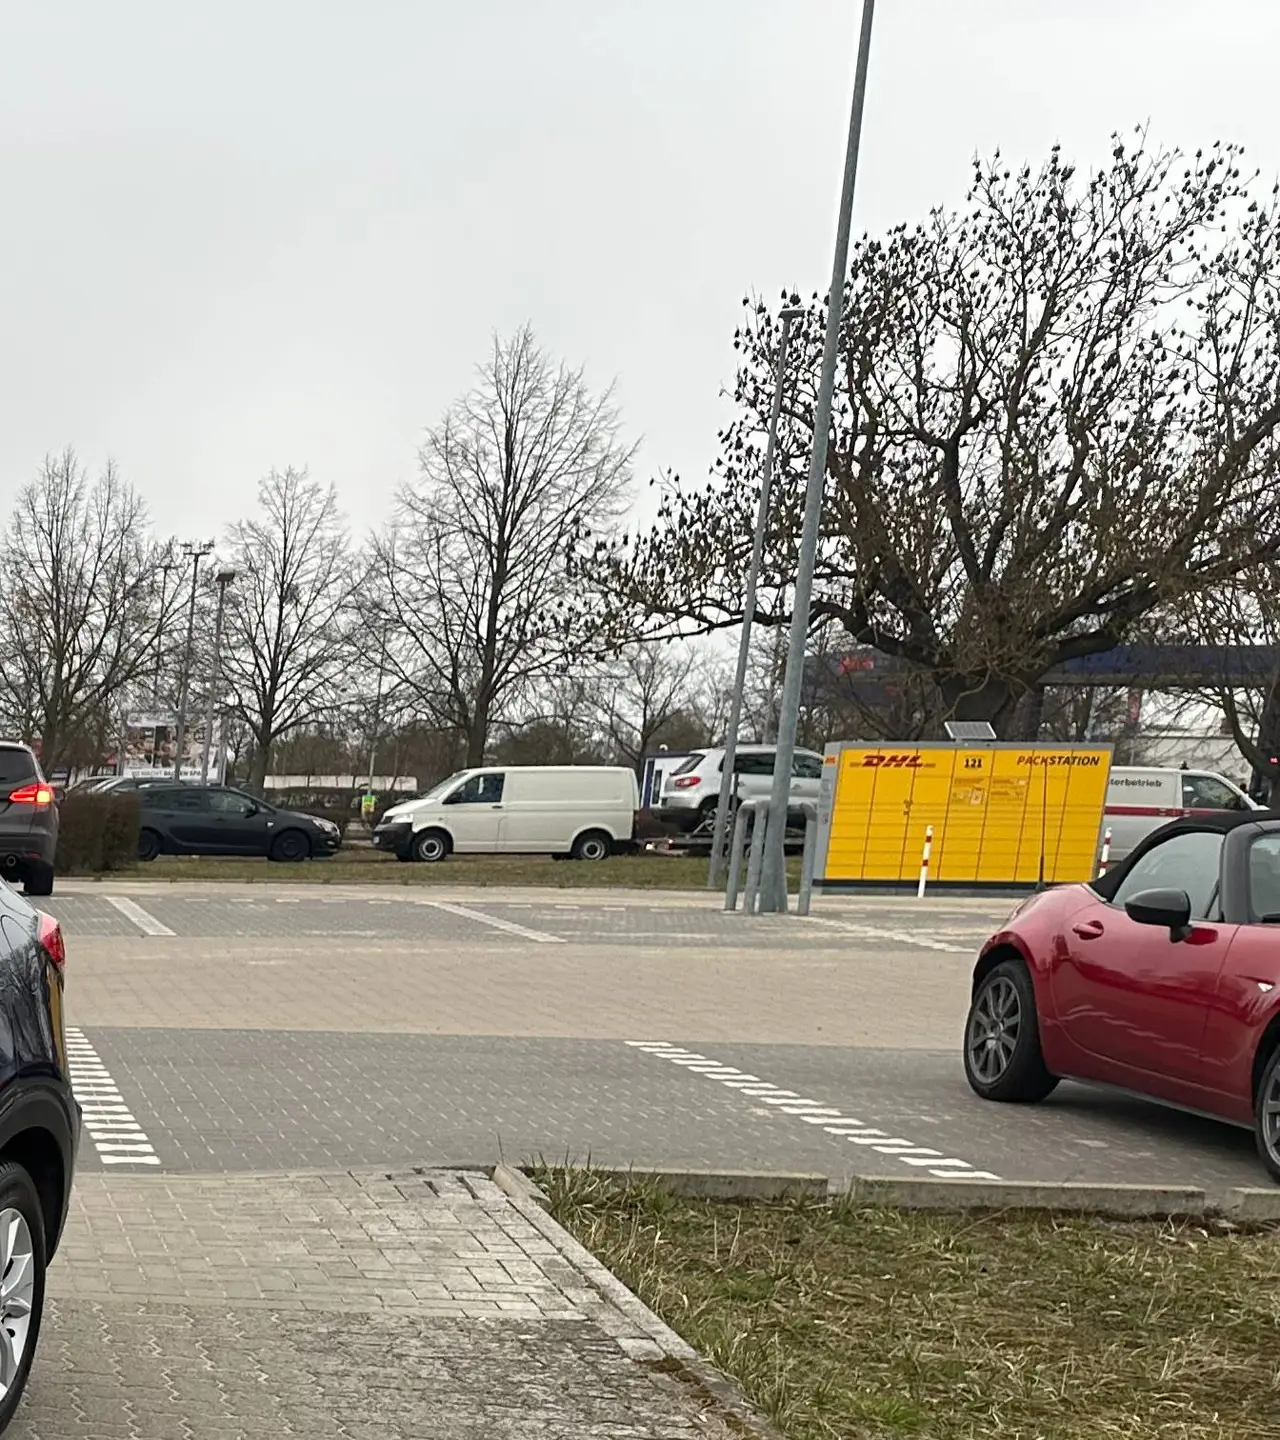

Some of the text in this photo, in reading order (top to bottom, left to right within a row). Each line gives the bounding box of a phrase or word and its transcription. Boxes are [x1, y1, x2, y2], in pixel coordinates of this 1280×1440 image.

[862, 755, 924, 767] DHL
[963, 757, 983, 769] 121
[1016, 754, 1101, 767] PACKSTATION
[1109, 778, 1162, 787] terbetrieb
